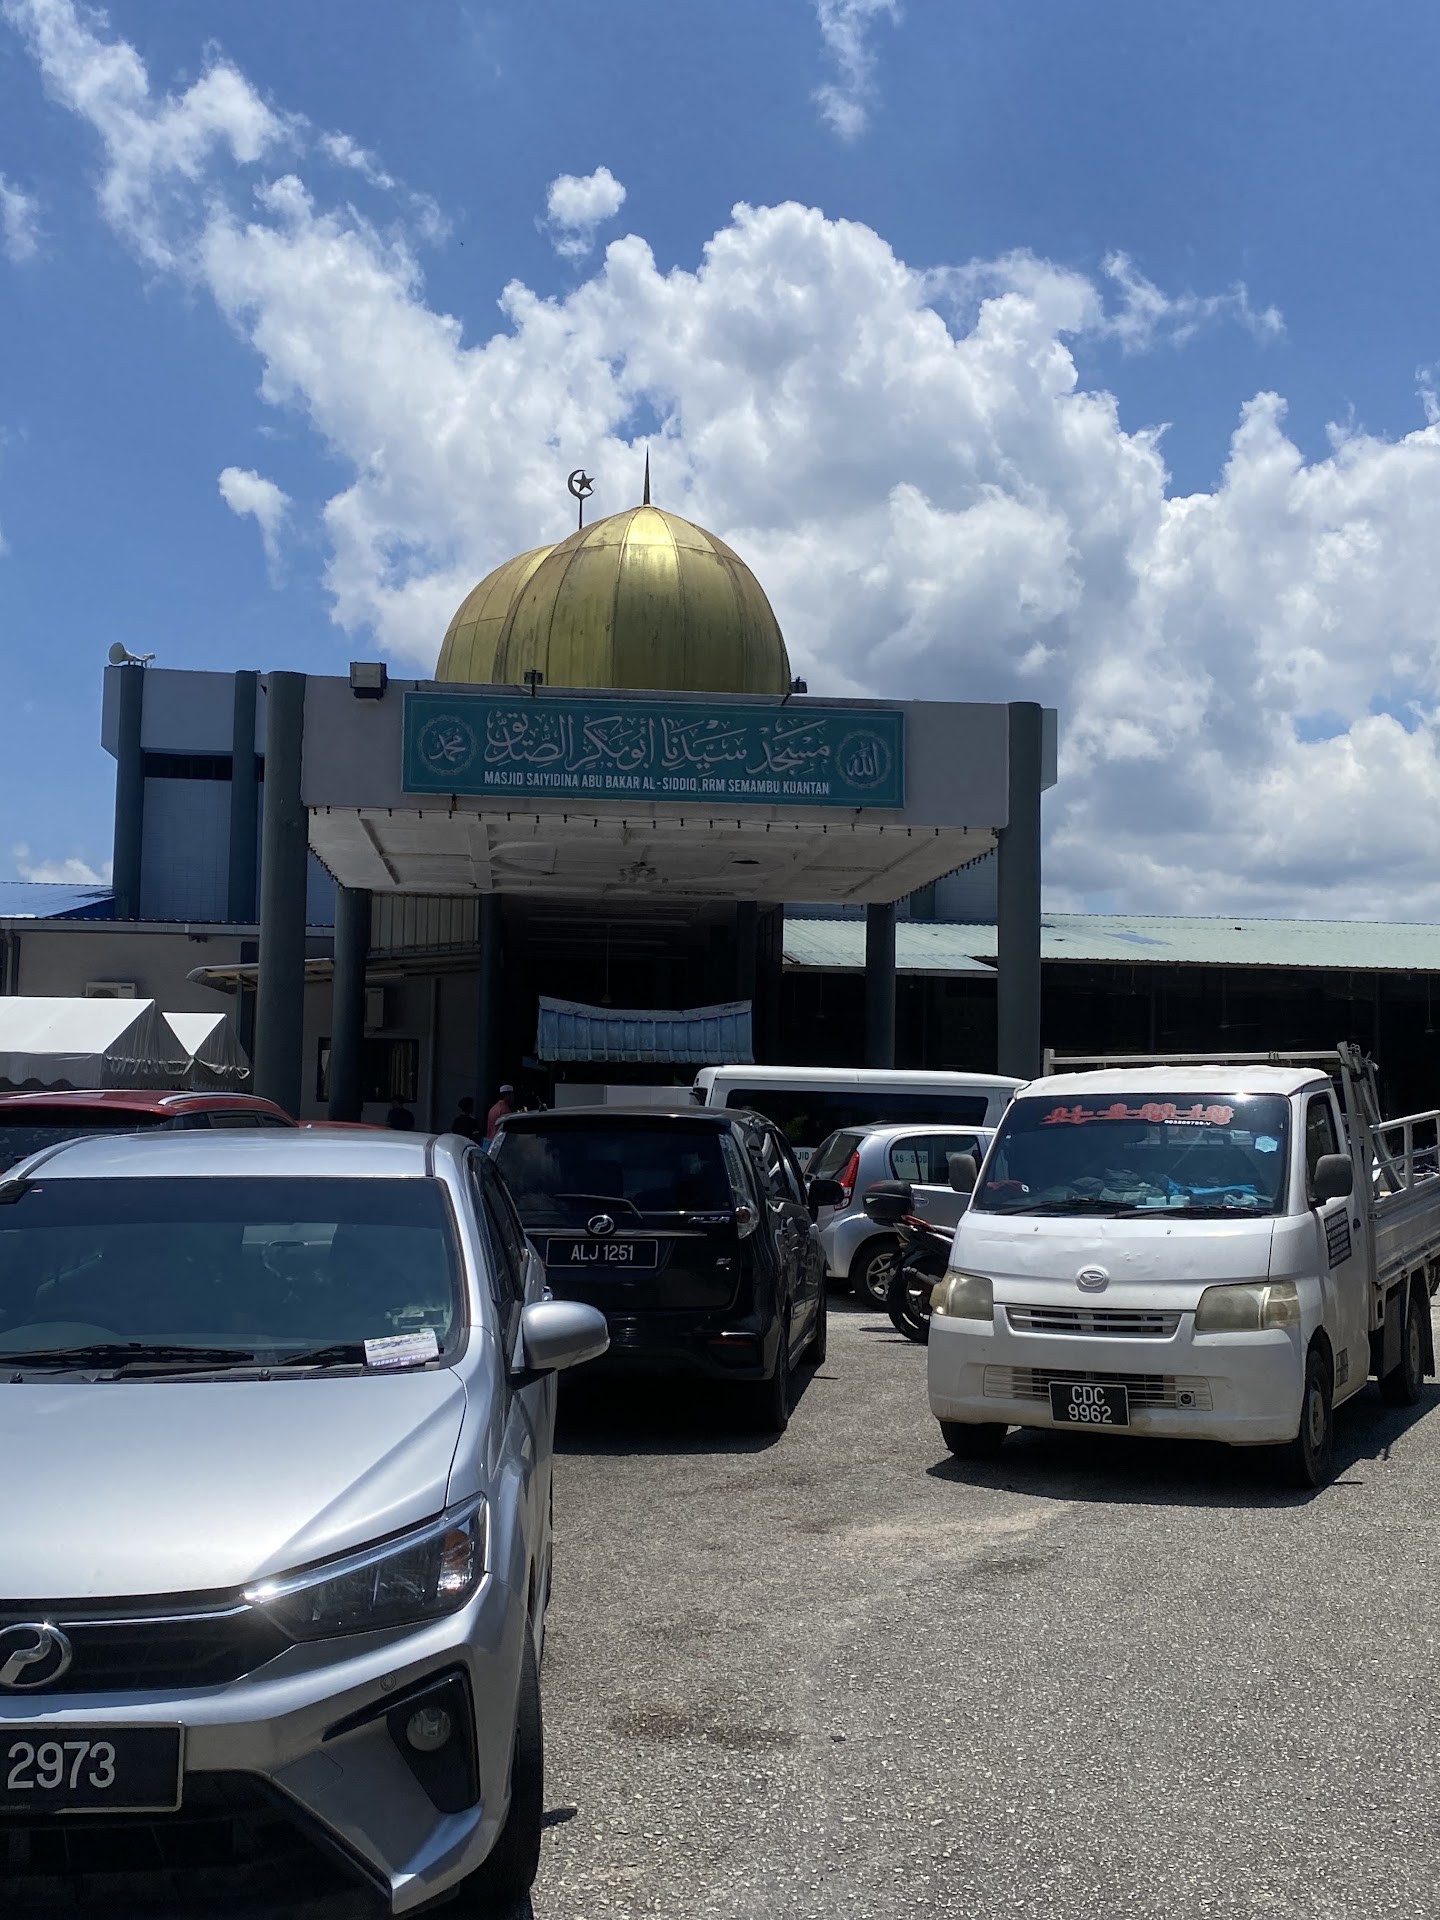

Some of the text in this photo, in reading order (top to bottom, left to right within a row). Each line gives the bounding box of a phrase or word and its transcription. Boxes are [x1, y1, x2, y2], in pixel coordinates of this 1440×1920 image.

[484, 771, 524, 785] MASJID
[526, 773, 579, 787] SAIYIDINA
[581, 775, 602, 788] ABU
[605, 776, 641, 789] BAKAR
[728, 780, 780, 794] SEMAMBU
[783, 781, 830, 795] KUANTAN
[570, 1244, 634, 1261] ALJ 1251
[1071, 1385, 1105, 1405] CDC
[1068, 1403, 1113, 1423] 9962
[7, 1741, 116, 1789] 2973
